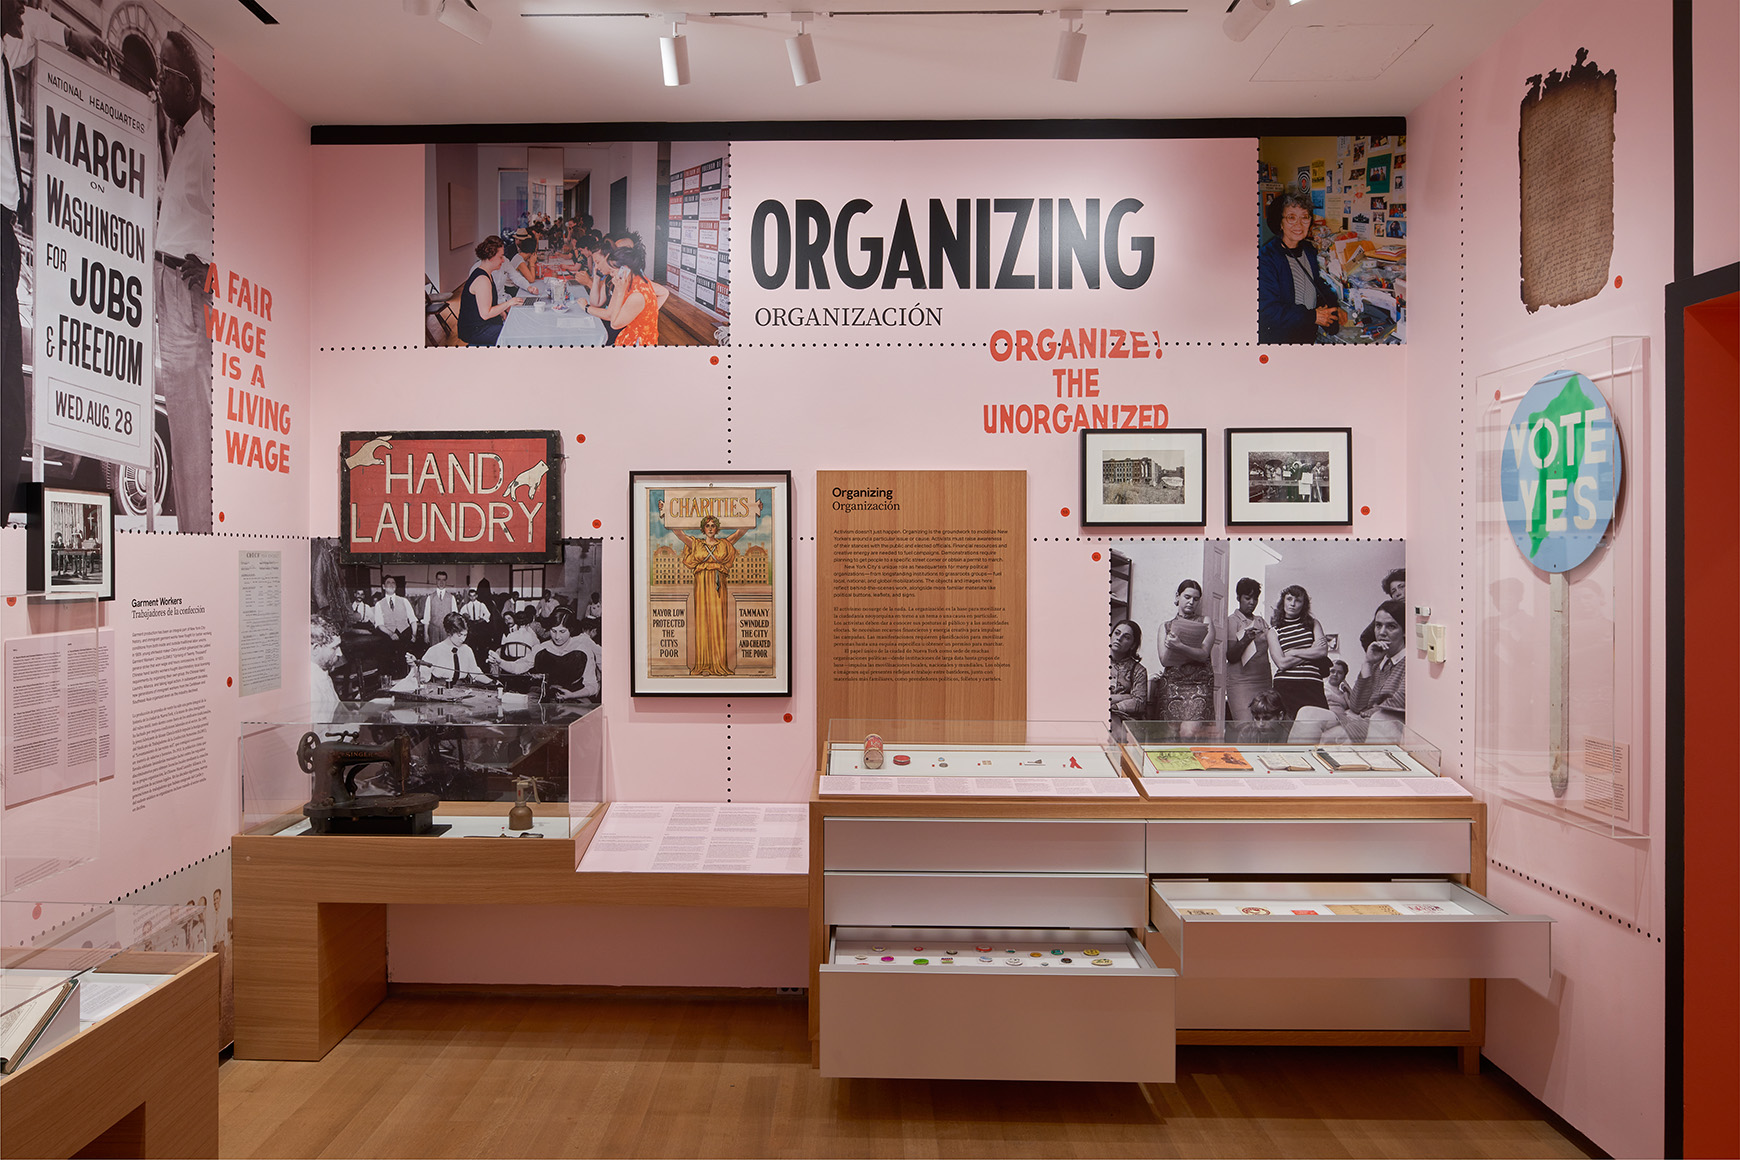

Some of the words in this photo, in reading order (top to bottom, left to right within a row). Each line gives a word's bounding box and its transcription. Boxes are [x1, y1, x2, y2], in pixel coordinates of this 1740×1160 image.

[47, 72, 84, 103] NATIONAL
[89, 95, 145, 133] HEADQUARTERS
[46, 105, 145, 199] MARCH
[90, 181, 105, 194] ON
[46, 174, 145, 264] WASHINGTON
[750, 197, 1155, 290] ORGANIZING
[46, 243, 67, 272] FOR
[70, 257, 143, 328] JOBS
[203, 262, 220, 299] A
[228, 270, 273, 322] FAIR
[203, 304, 266, 359] WAGE
[754, 302, 943, 327] ORGANIZACIÓN
[46, 325, 55, 358] &
[58, 314, 143, 386] FREEDOM
[989, 327, 1164, 362] ORGANIZE!
[222, 352, 242, 381] IS
[251, 364, 266, 389] A
[1051, 368, 1100, 398] THE
[115, 408, 133, 435] 28
[227, 386, 291, 436] LIVING
[983, 403, 1170, 434] UNORGANIZED
[225, 429, 290, 474] WAGE
[1510, 406, 1607, 469] VOTE
[385, 452, 504, 495] HAND
[669, 497, 749, 518] CHARITIES
[832, 487, 893, 500] Organizing
[832, 500, 900, 513] Organización
[1519, 476, 1598, 532] YES
[351, 501, 544, 543] LAUNDRY
[132, 598, 158, 608] Garment
[159, 597, 182, 606] Workers
[132, 608, 166, 620] Trabajadores
[167, 608, 173, 616] de
[174, 607, 179, 615] la
[180, 605, 205, 615] confección
[739, 609, 770, 617] TAMMANY
[653, 619, 685, 628] PROTECTED
[660, 649, 678, 657] POOR
[742, 649, 752, 658] THE
[754, 649, 768, 658] POOR
[750, 640, 771, 648] CHEATED
